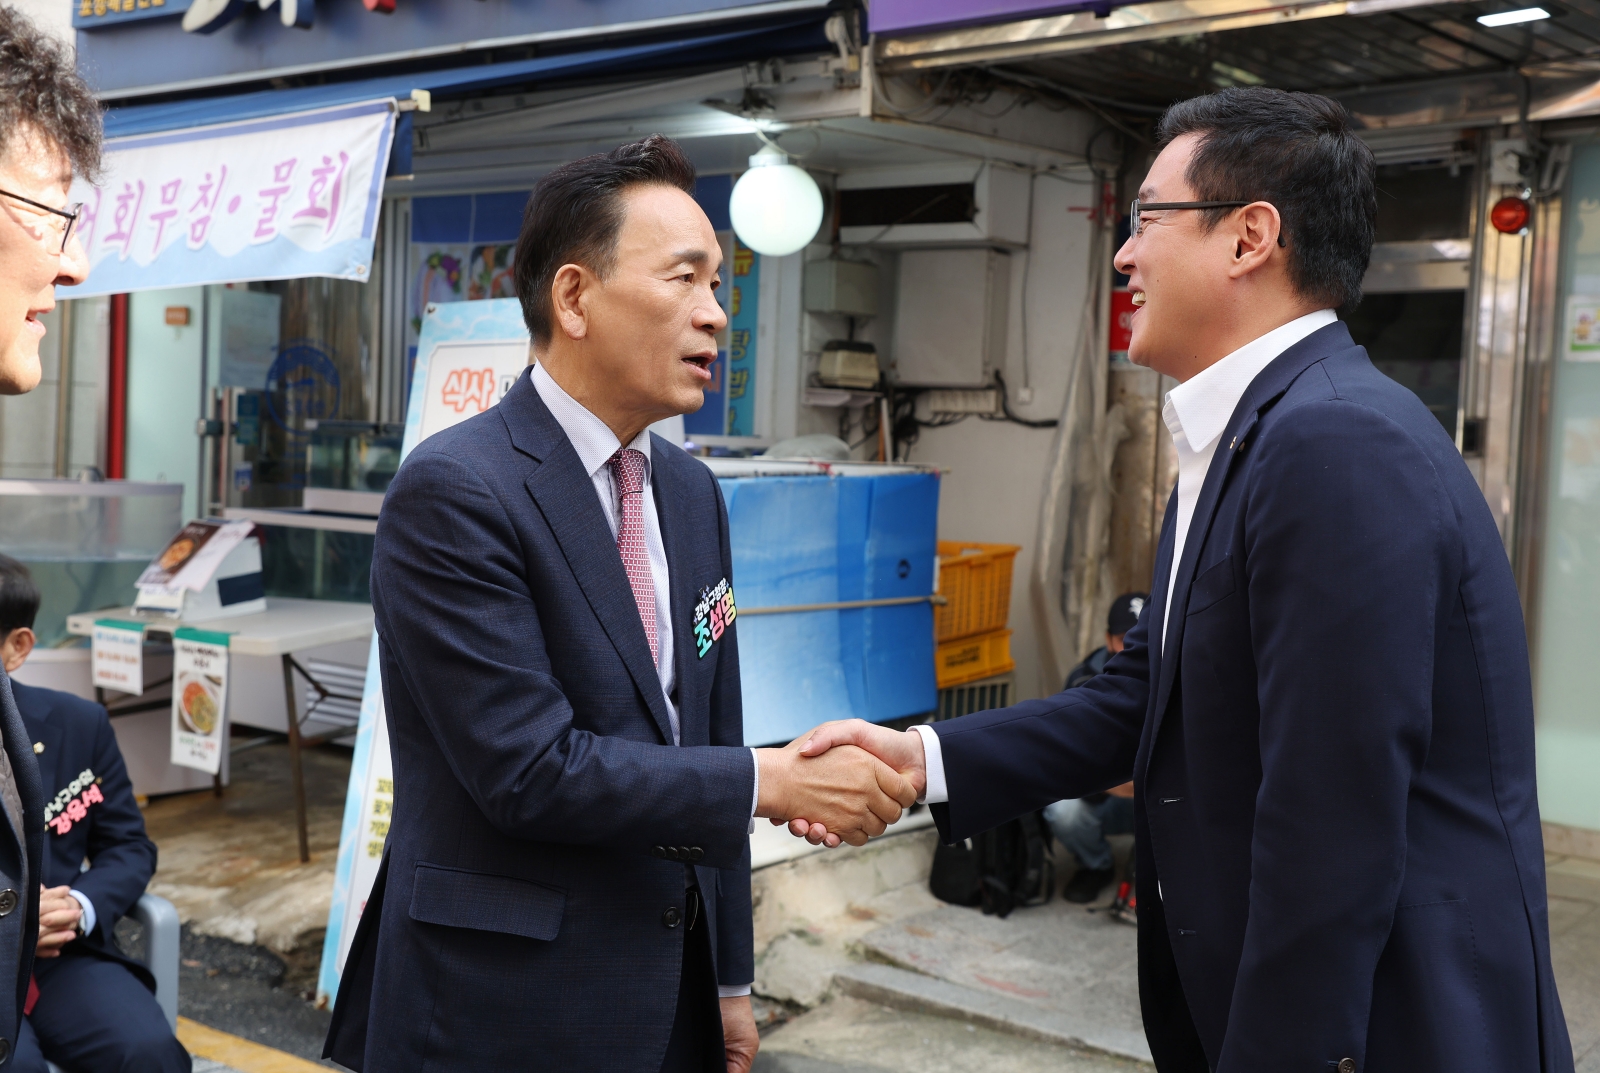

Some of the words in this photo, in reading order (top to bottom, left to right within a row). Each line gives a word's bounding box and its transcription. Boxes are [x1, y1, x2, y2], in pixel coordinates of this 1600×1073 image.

[442, 368, 495, 412] 식사
[695, 578, 727, 621] 강남구청장
[694, 587, 737, 658] 조성명
